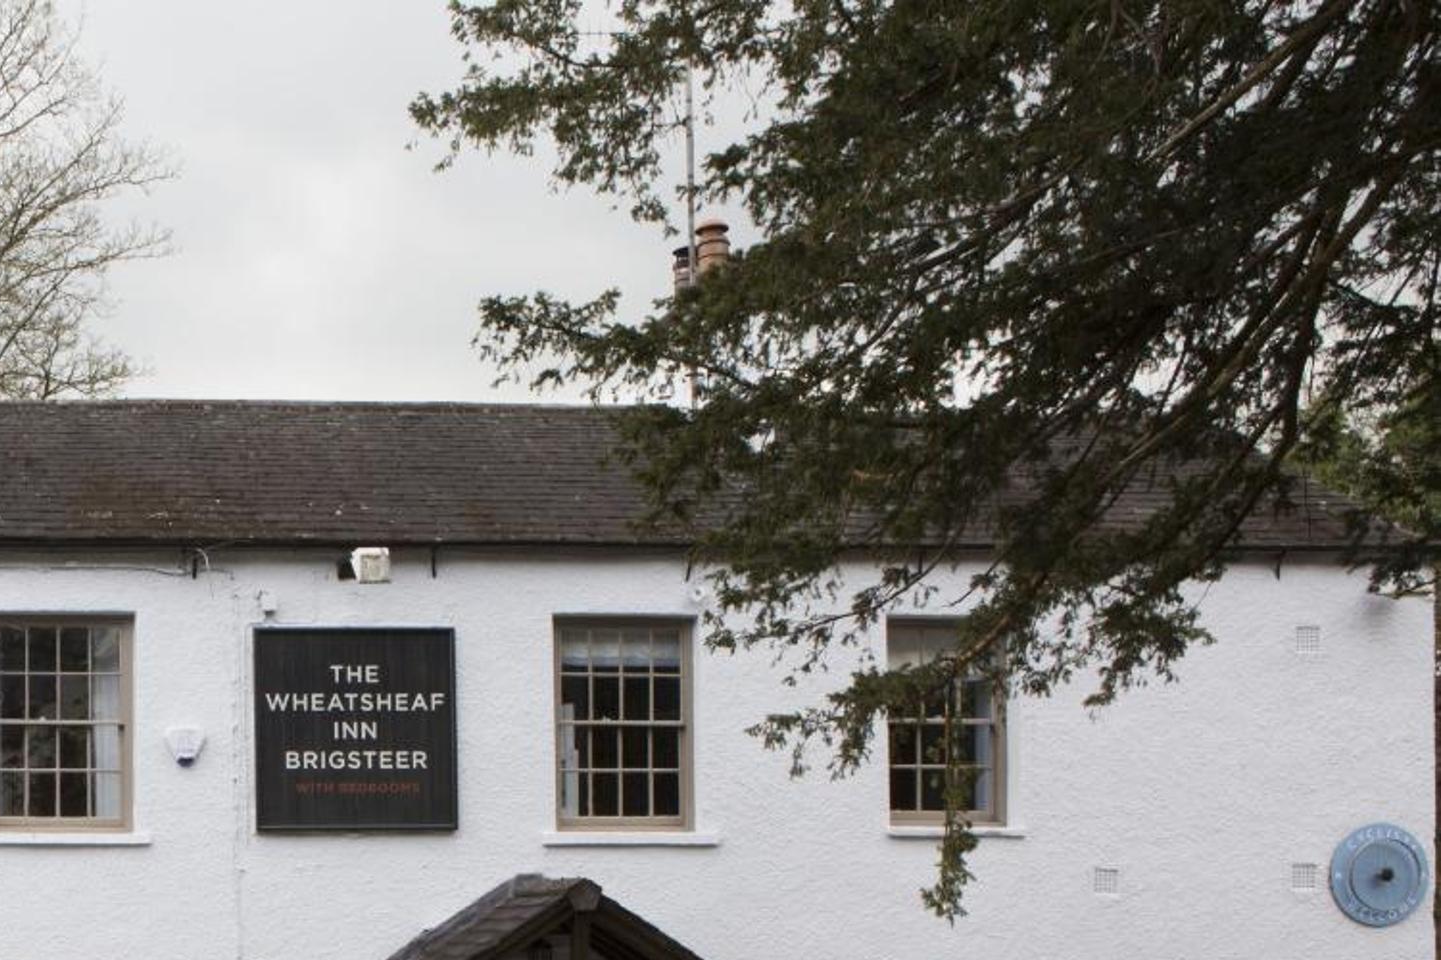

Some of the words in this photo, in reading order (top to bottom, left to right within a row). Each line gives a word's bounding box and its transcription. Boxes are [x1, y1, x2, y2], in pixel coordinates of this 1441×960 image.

[329, 664, 381, 684] THE
[265, 692, 446, 712] WHEATSHEAF
[333, 720, 378, 740] INN
[285, 751, 428, 770] BRIGSTEER
[296, 782, 334, 794] WITH
